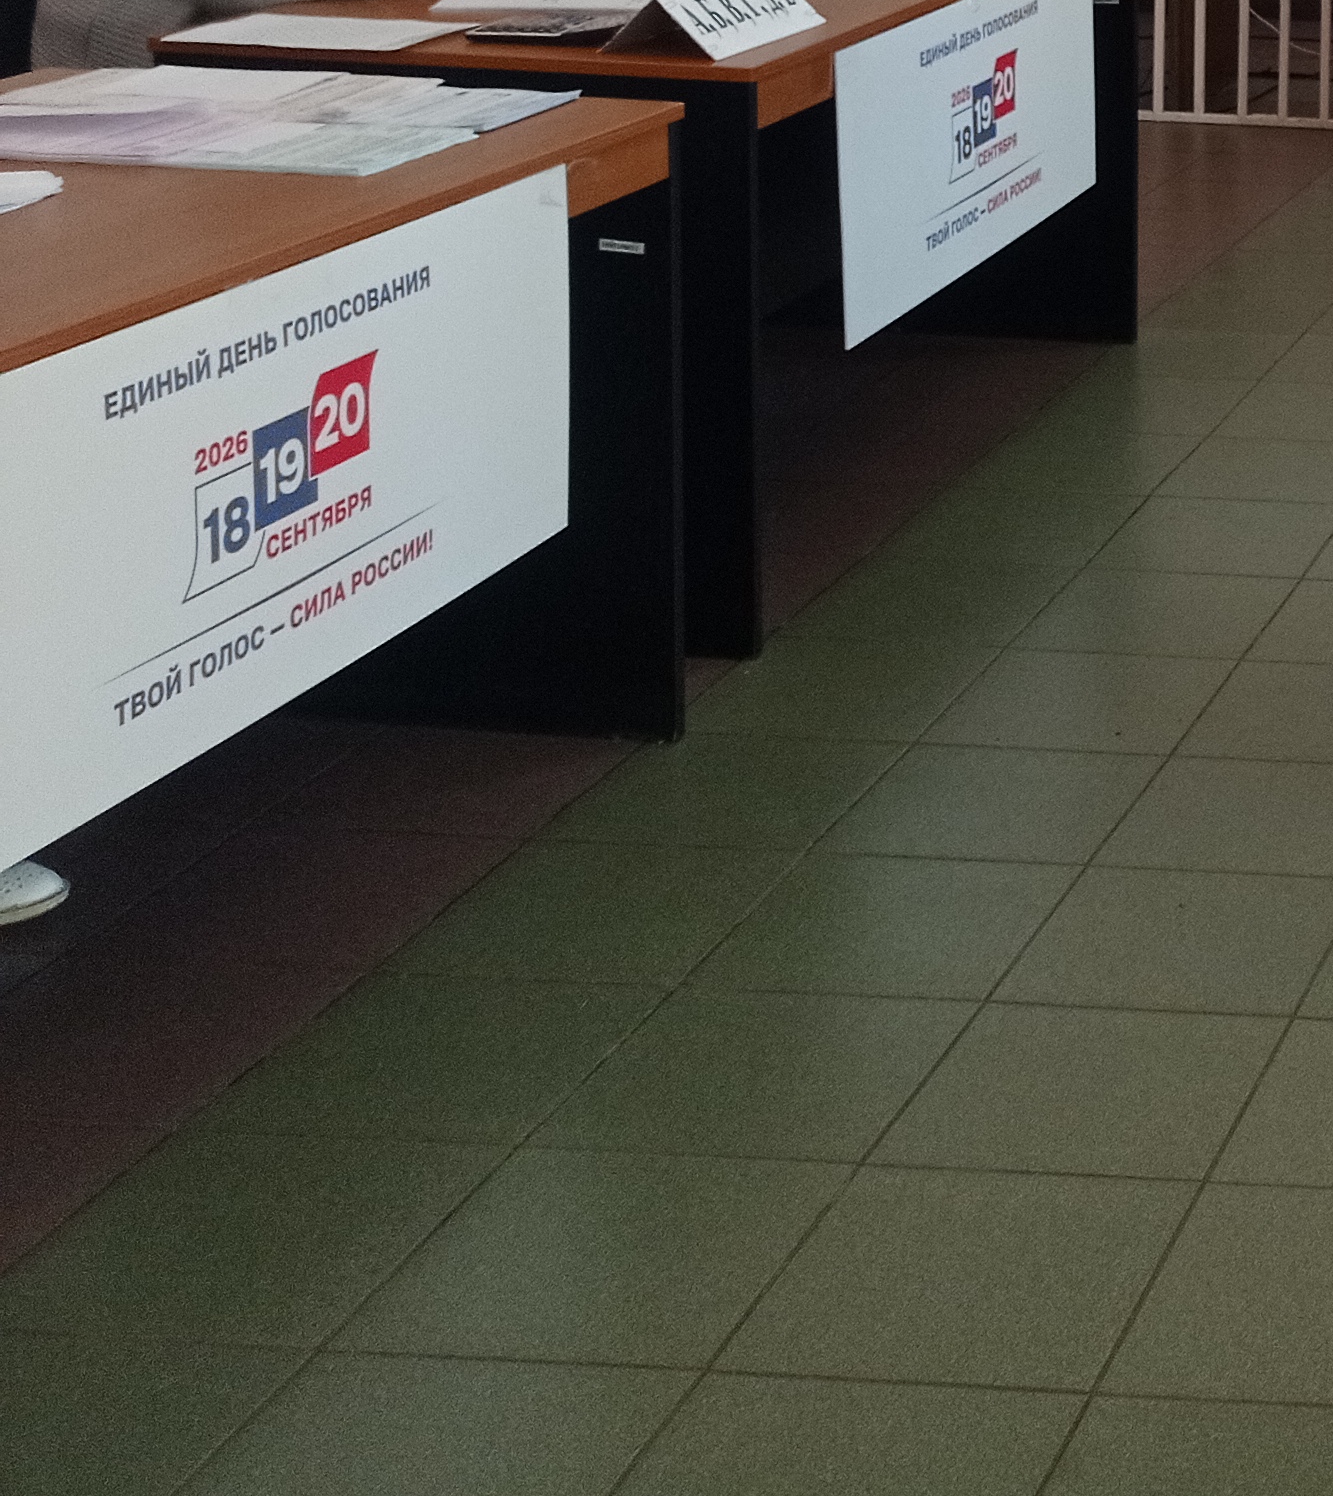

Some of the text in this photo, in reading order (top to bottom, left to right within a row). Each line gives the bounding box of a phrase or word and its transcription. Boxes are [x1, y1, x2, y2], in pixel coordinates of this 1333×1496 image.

[920, 0, 1039, 68] ЕДИНЫЙ ДЕНЬ ГОЛОСОВАНИЯ
[951, 85, 970, 108] 2026
[955, 66, 1014, 164] 18 19 20
[978, 132, 1018, 168] СЕНТЯБРЯ
[925, 221, 949, 252] ТВОЙ
[951, 207, 979, 236] ГОЛОС
[987, 189, 1008, 214] СИЛА
[103, 265, 430, 420] ЕДИНЫЙ ДЕНЬ ГОЛОСОВАНИЯ
[194, 429, 248, 475] 2026
[203, 381, 366, 565] 18 19 20
[265, 484, 372, 559] СЕНТЯБРЯ
[113, 663, 182, 727] ТВОЙ
[188, 625, 265, 688] ГОЛОС
[289, 581, 346, 629] СИЛА
[351, 528, 434, 595] РОССИИ!
